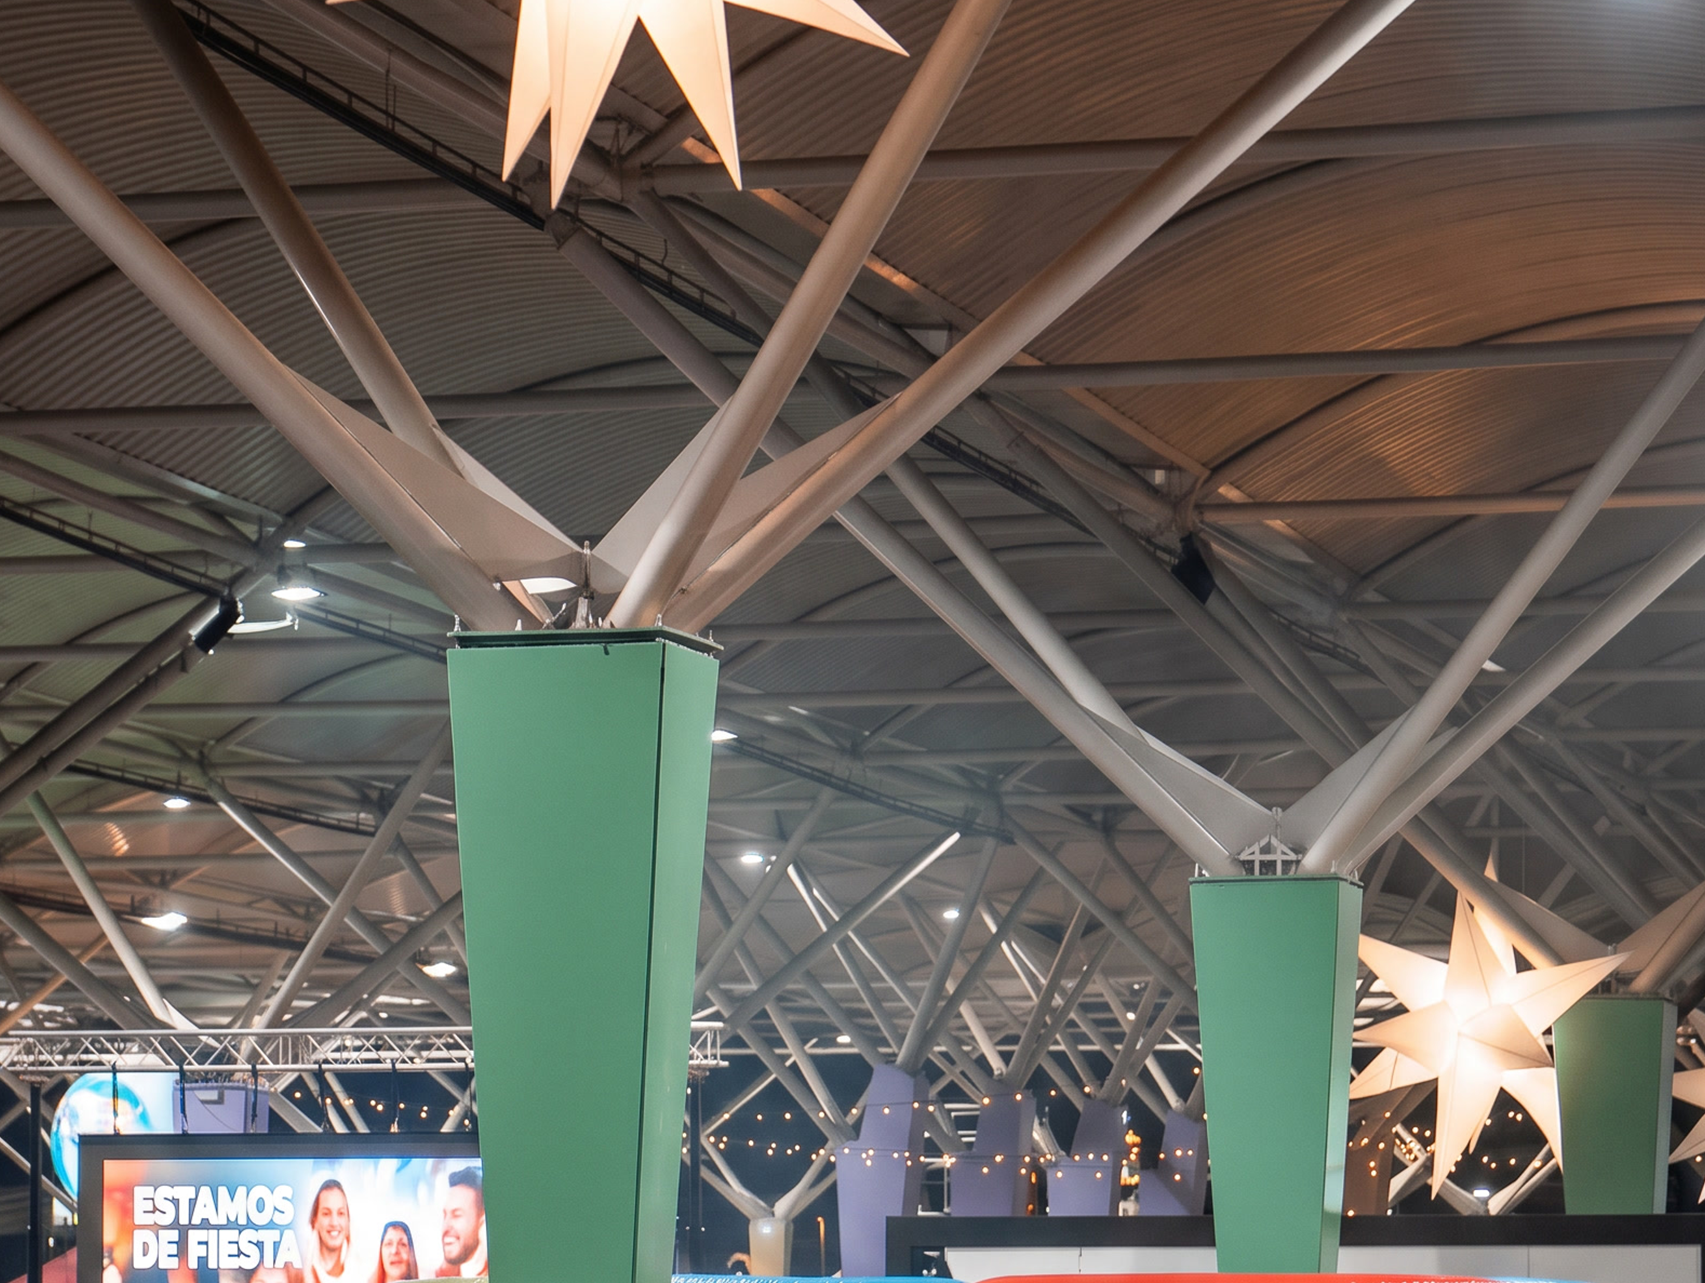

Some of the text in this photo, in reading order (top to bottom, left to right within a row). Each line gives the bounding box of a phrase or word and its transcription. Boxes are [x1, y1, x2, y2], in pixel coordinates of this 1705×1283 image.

[132, 1185, 294, 1226] ESTAMOS
[132, 1229, 303, 1269] DE FIESTA
